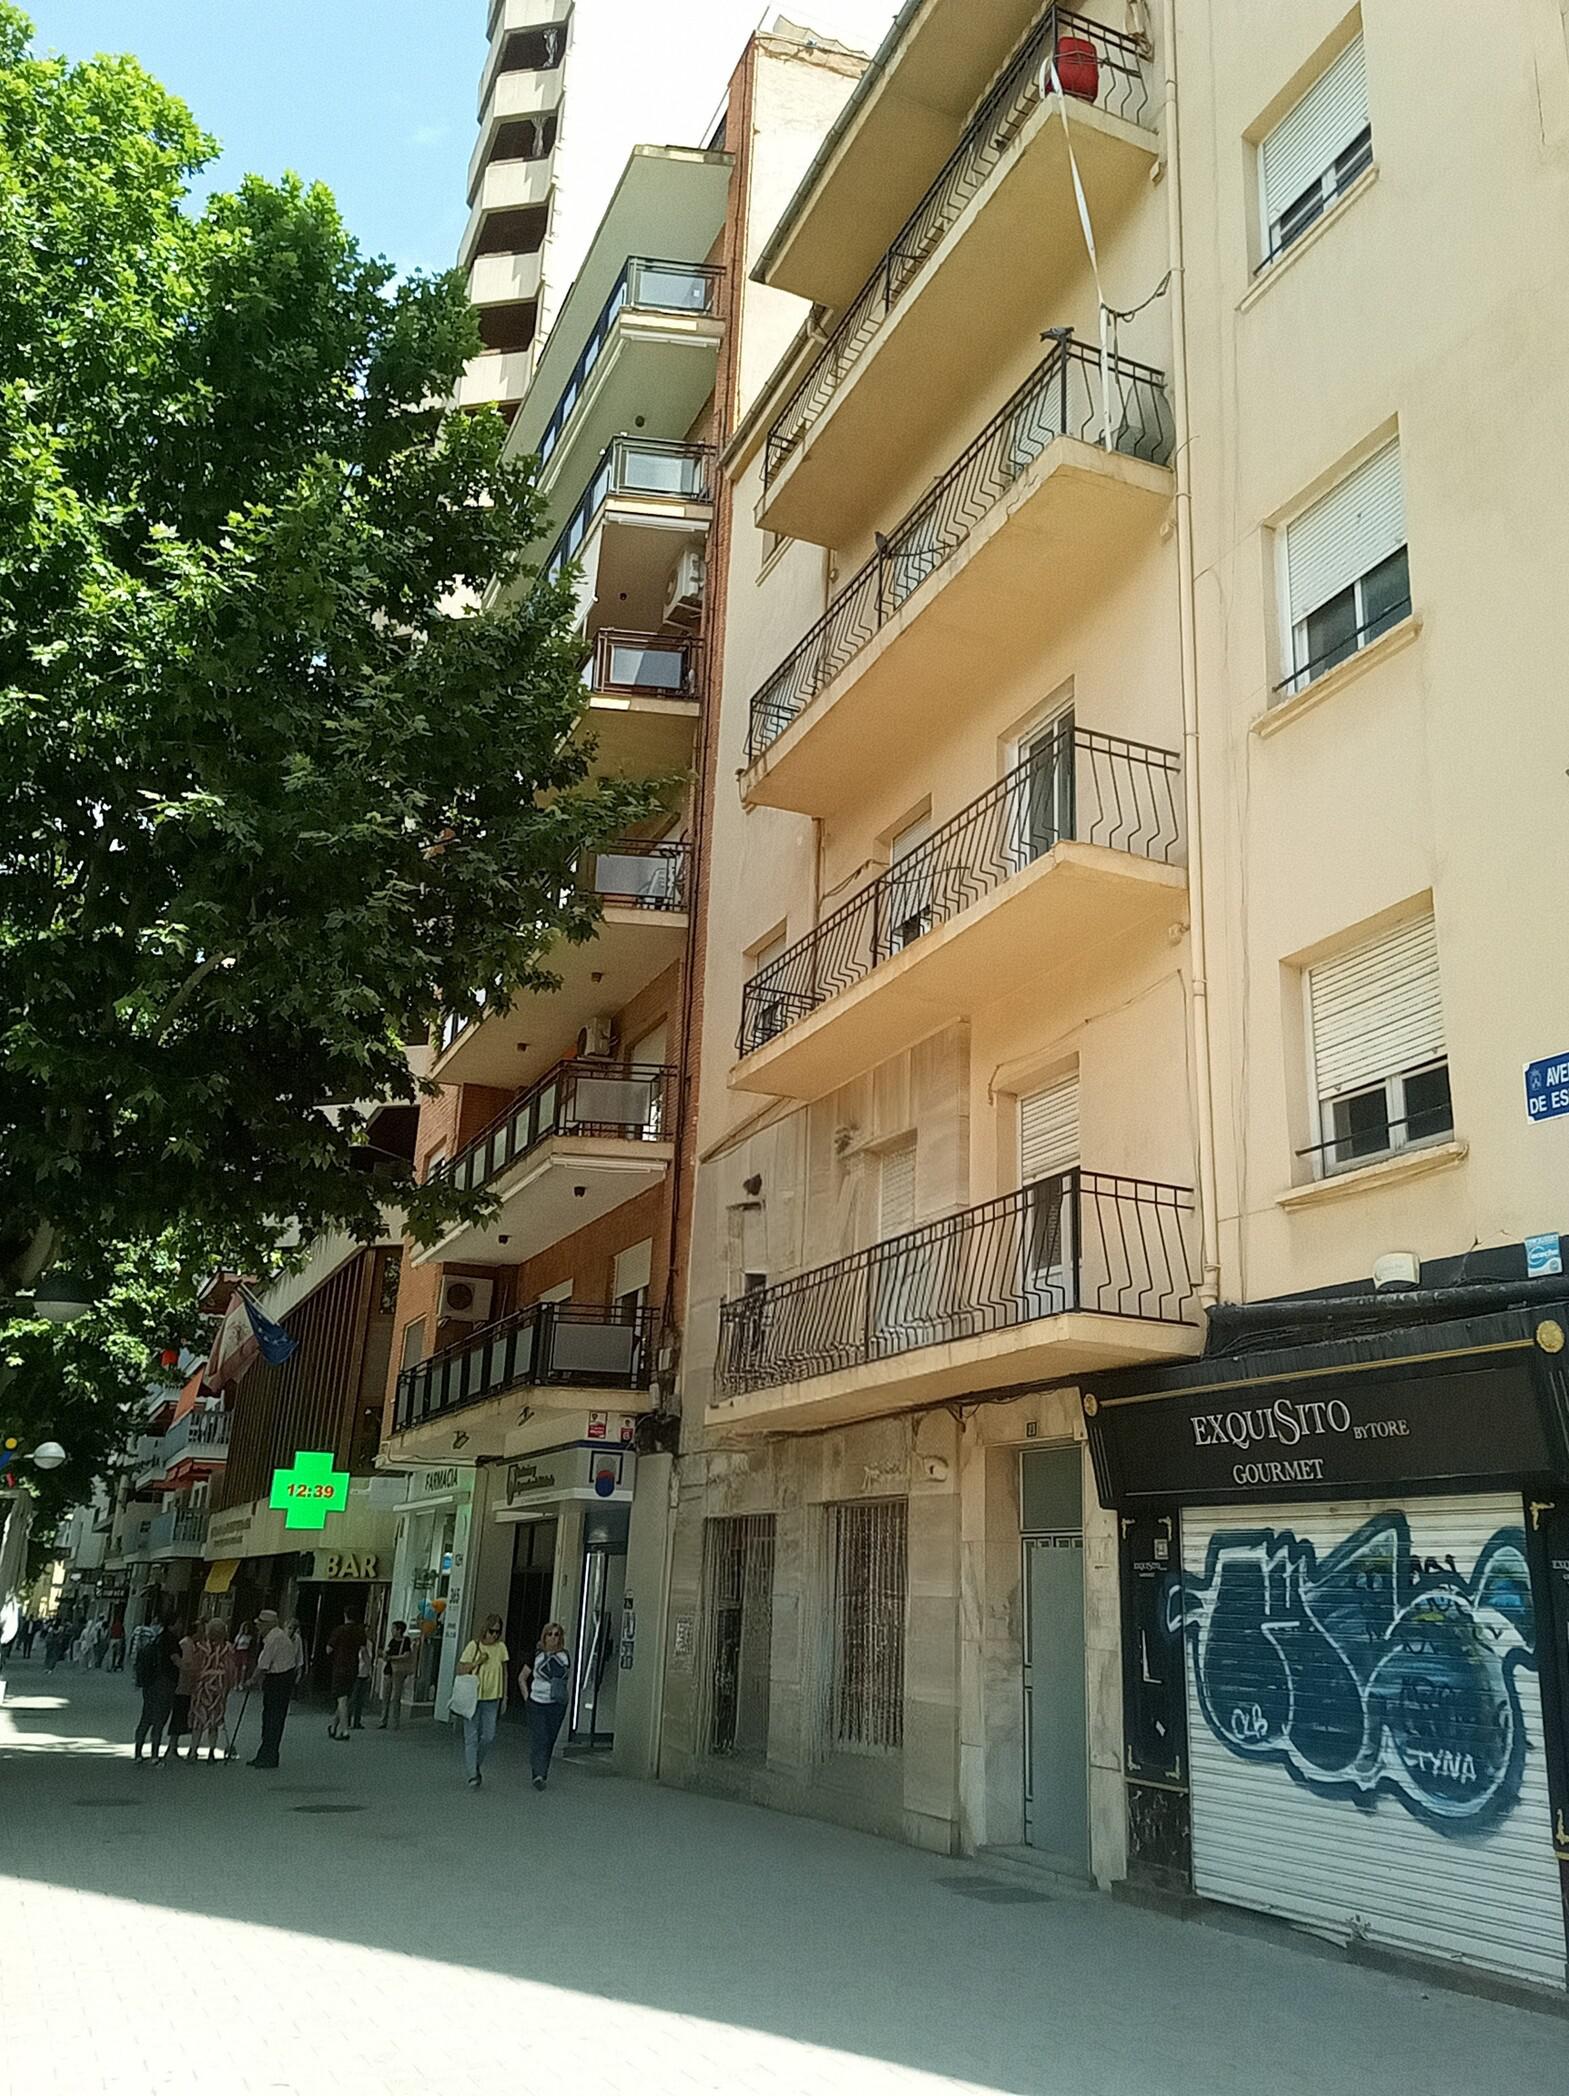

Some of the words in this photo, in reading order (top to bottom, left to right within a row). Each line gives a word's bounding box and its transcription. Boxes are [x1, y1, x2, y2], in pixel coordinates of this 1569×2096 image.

[1546, 1062, 1569, 1087] AVE
[1530, 1094, 1548, 1115] DE
[1551, 1088, 1569, 1109] ES
[1190, 1399, 1350, 1450] EXQUISITO
[424, 1467, 459, 1493] FARMACIA
[1232, 1458, 1324, 1484] GOURMET
[287, 1483, 335, 1499] 12:39
[326, 1552, 377, 1579] BAR
